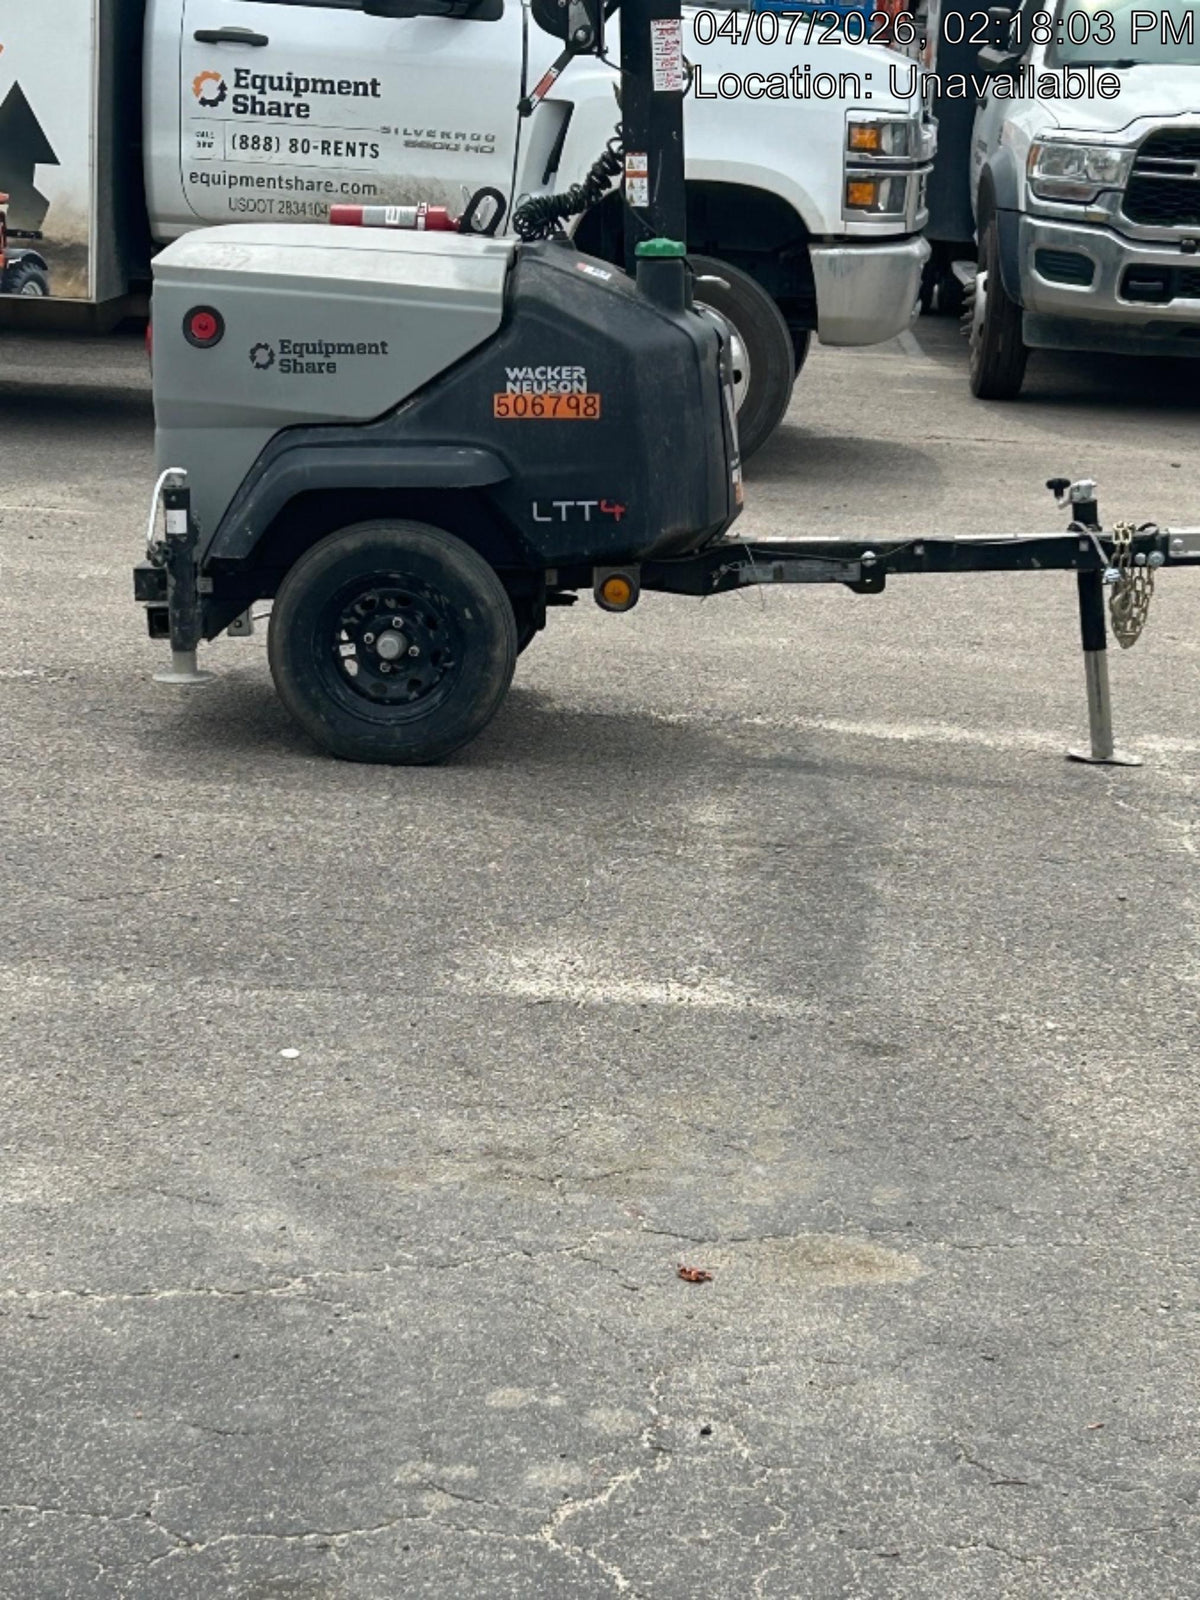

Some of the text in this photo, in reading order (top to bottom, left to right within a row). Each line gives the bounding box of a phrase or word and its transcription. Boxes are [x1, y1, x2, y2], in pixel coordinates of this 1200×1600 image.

[234, 68, 381, 98] Equipment
[232, 94, 310, 118] Share
[231, 133, 380, 159] (888) 80-RENTS
[189, 170, 378, 196] equipmentshare.com
[228, 197, 275, 213] USDOT
[278, 339, 388, 358] Equipment
[278, 358, 337, 374] Share
[505, 366, 587, 380] WACKER
[506, 380, 587, 394] NEUSON
[496, 395, 598, 417] 506798
